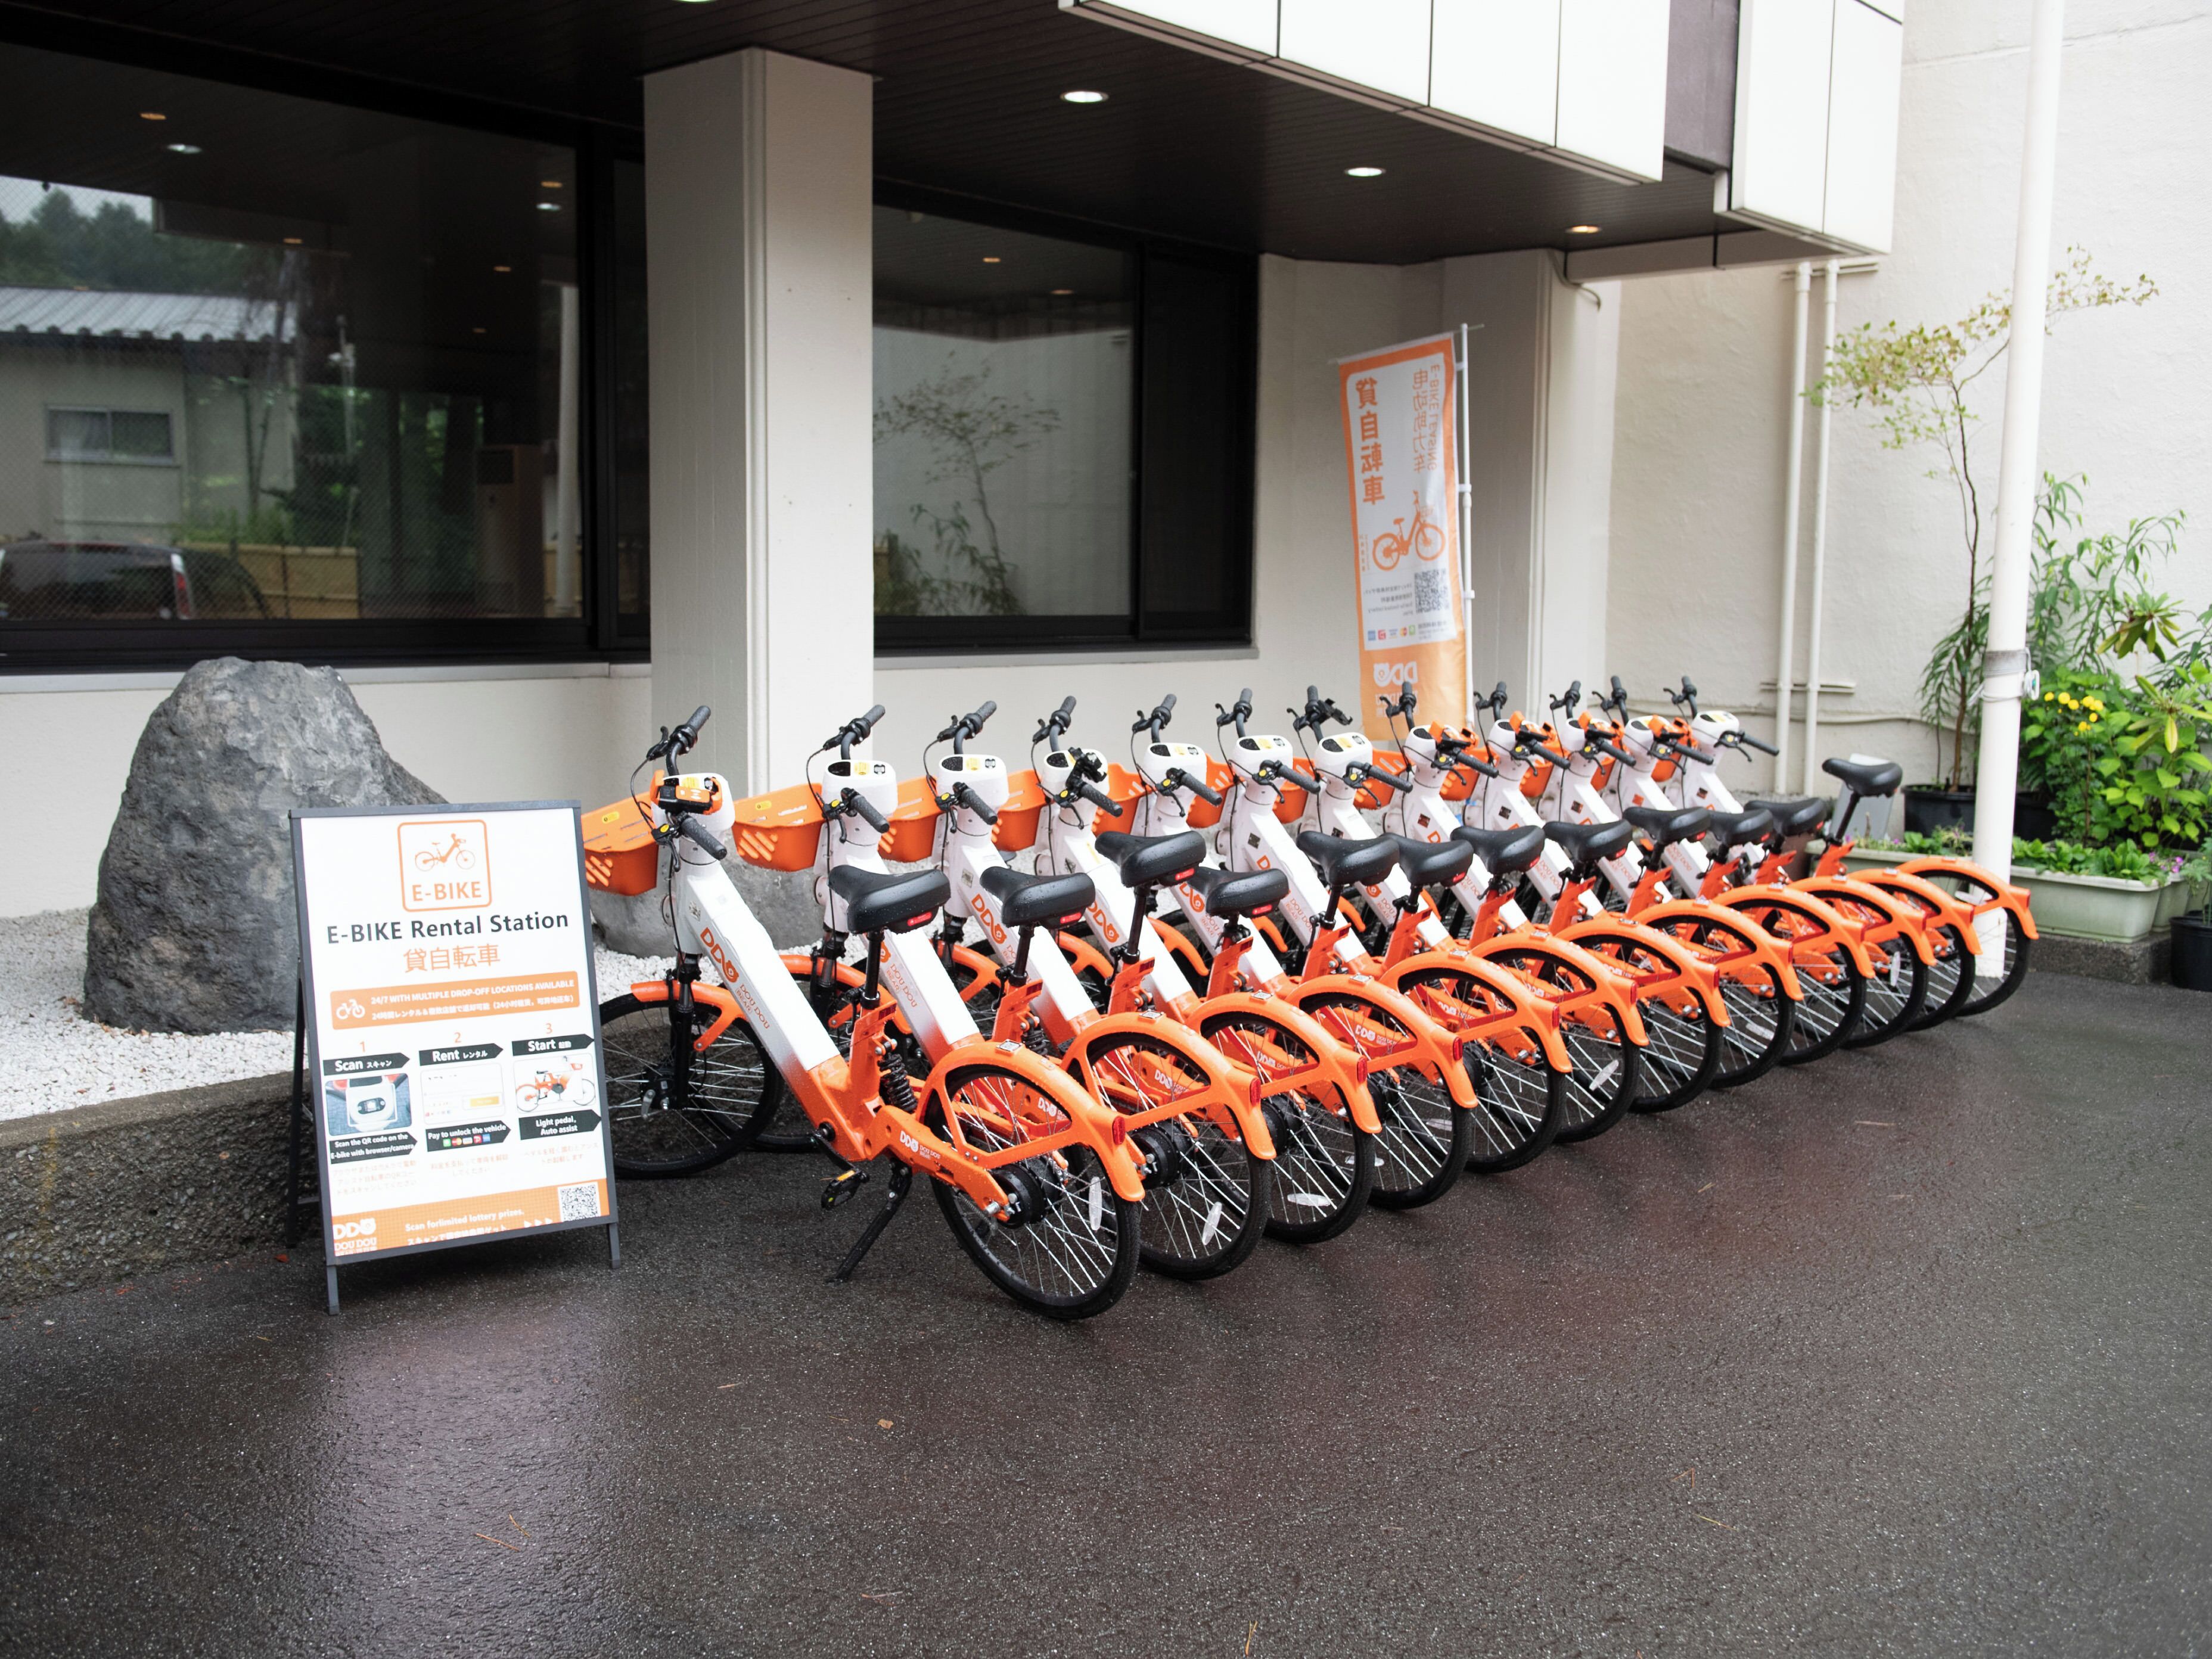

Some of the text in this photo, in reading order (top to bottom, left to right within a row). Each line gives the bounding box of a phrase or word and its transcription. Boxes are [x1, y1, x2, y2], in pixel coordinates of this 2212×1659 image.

[411, 880, 481, 902] E-BIKE
[1290, 898, 1303, 915] DOU
[326, 909, 568, 945] E-BIKE Rental Station
[402, 942, 501, 974] 貸自転車
[370, 979, 574, 1005] 24/7 WITH MULTIPLE DROP-OFF LOCATIONS AVAILABLE
[890, 964, 918, 1008] DOU DOU
[737, 990, 751, 1011] BEAR
[740, 984, 771, 1029] DOU DOU
[545, 1023, 552, 1034] 3
[453, 1032, 462, 1043] 2
[527, 1037, 557, 1052] Start
[359, 1040, 365, 1052] 1
[432, 1048, 460, 1062] Rent
[462, 1049, 488, 1059] レンタル
[334, 1058, 363, 1072] Scan
[366, 1059, 392, 1068] スキャン
[535, 1117, 554, 1129] Light
[540, 1123, 578, 1136] Auto assist
[427, 1131, 440, 1141] Pay
[449, 1127, 471, 1137] unlock
[471, 1126, 483, 1134] the
[483, 1123, 507, 1133] vehicle
[334, 1139, 350, 1148] Scan
[361, 1136, 372, 1145] QR
[372, 1135, 387, 1144] code
[397, 1132, 408, 1141] the
[330, 1150, 350, 1160] E-bike
[350, 1148, 365, 1157] with
[405, 1221, 425, 1232] Scan
[468, 1210, 496, 1225] lottery
[498, 1207, 524, 1220] prizes.
[334, 1237, 377, 1251] DOU DOU
